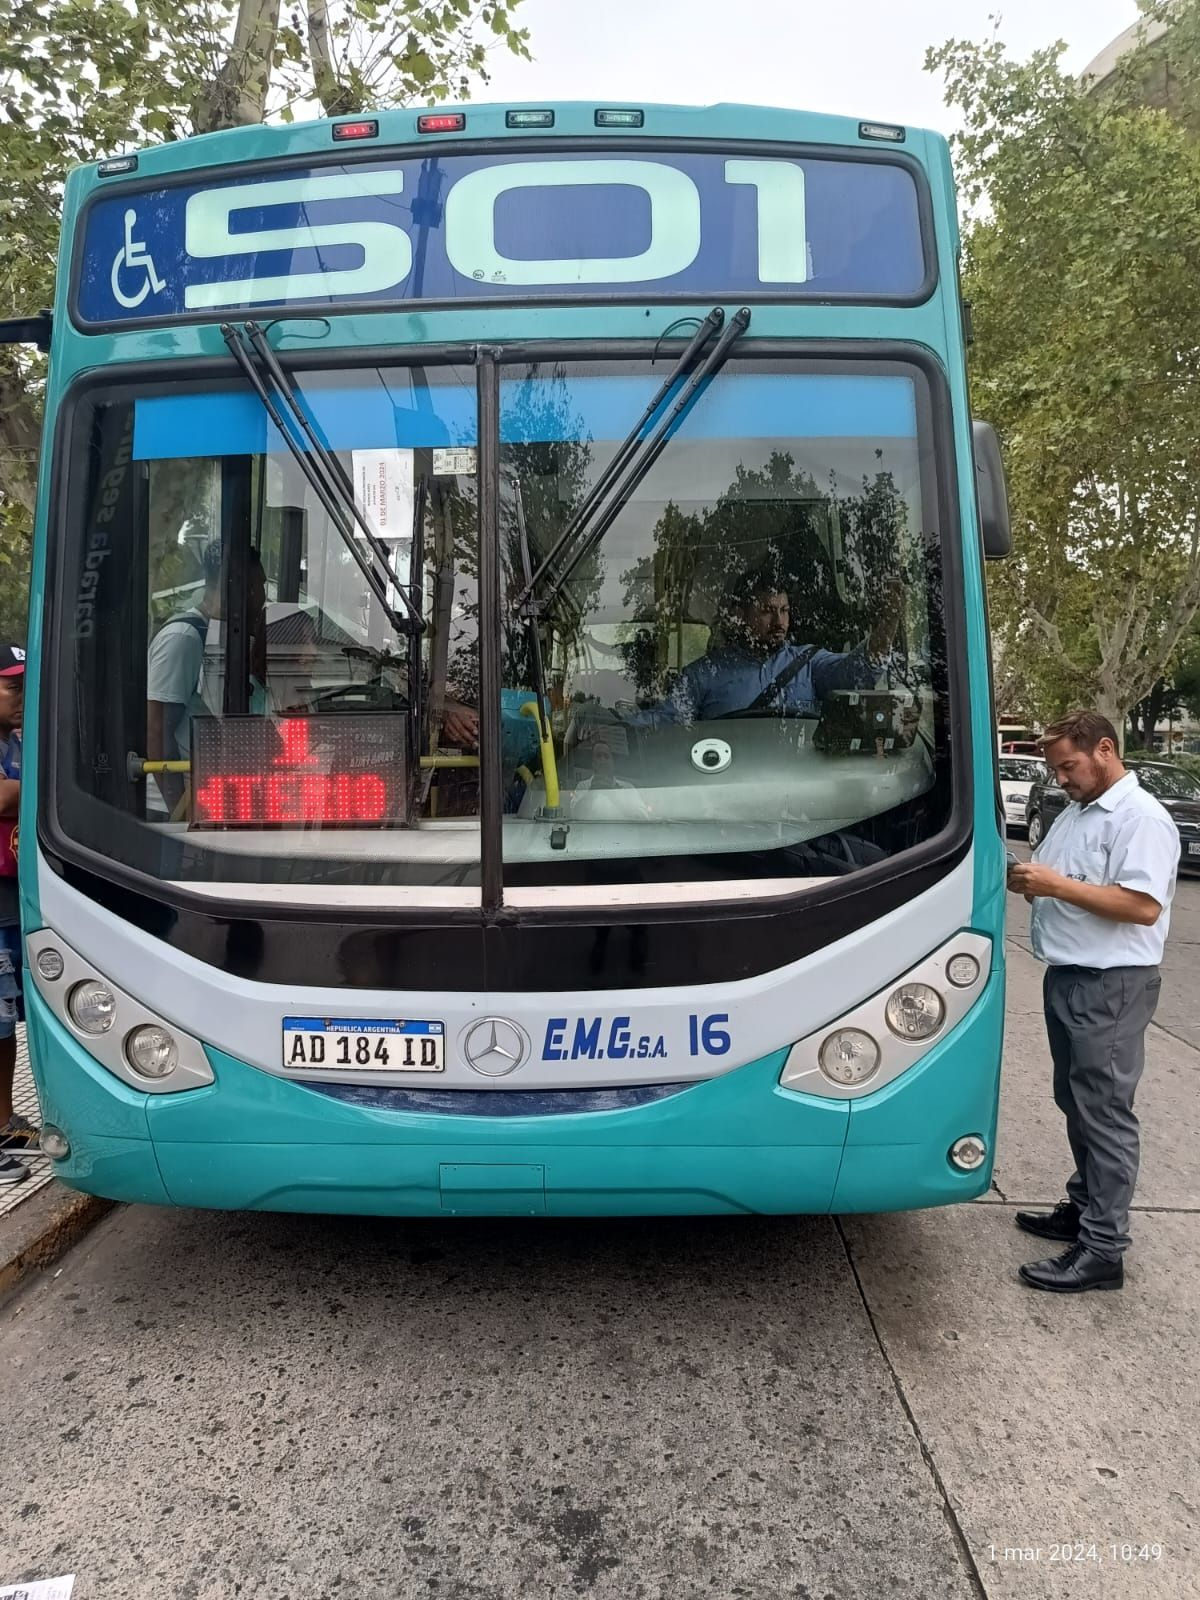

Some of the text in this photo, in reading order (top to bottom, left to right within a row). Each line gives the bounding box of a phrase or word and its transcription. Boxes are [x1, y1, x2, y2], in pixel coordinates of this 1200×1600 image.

[363, 1026, 401, 1034] ARGENTINA
[688, 1013, 731, 1056] 16
[291, 1034, 436, 1066] AD 184 ID
